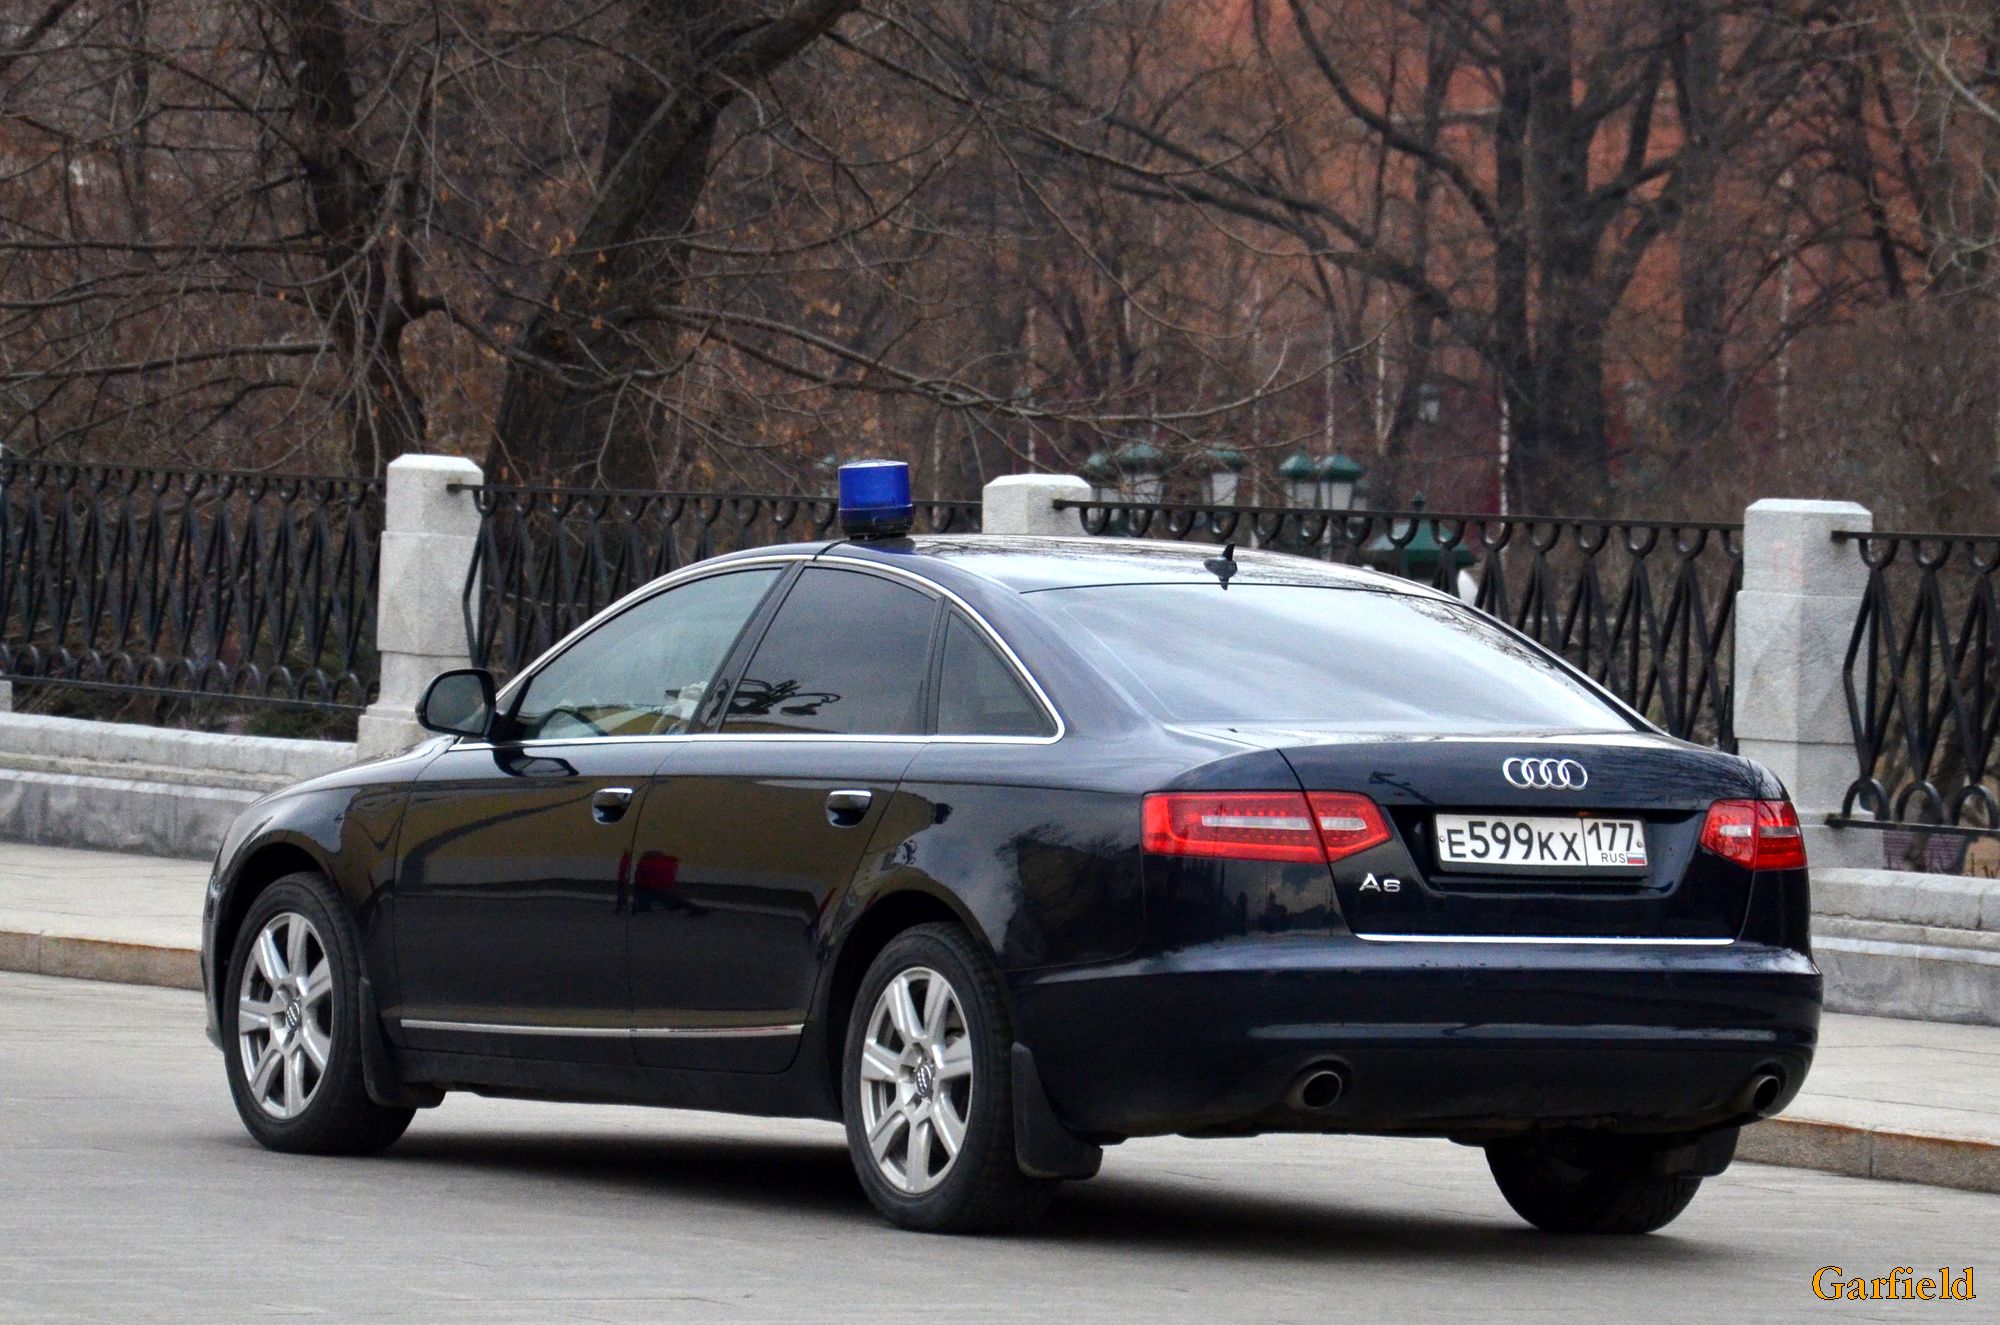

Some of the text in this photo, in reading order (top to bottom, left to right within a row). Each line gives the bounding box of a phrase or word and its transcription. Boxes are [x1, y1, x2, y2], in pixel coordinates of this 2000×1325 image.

[1446, 821, 1635, 862] E599KX 177
[1601, 852, 1627, 864] RUS
[1358, 872, 1401, 893] A6
